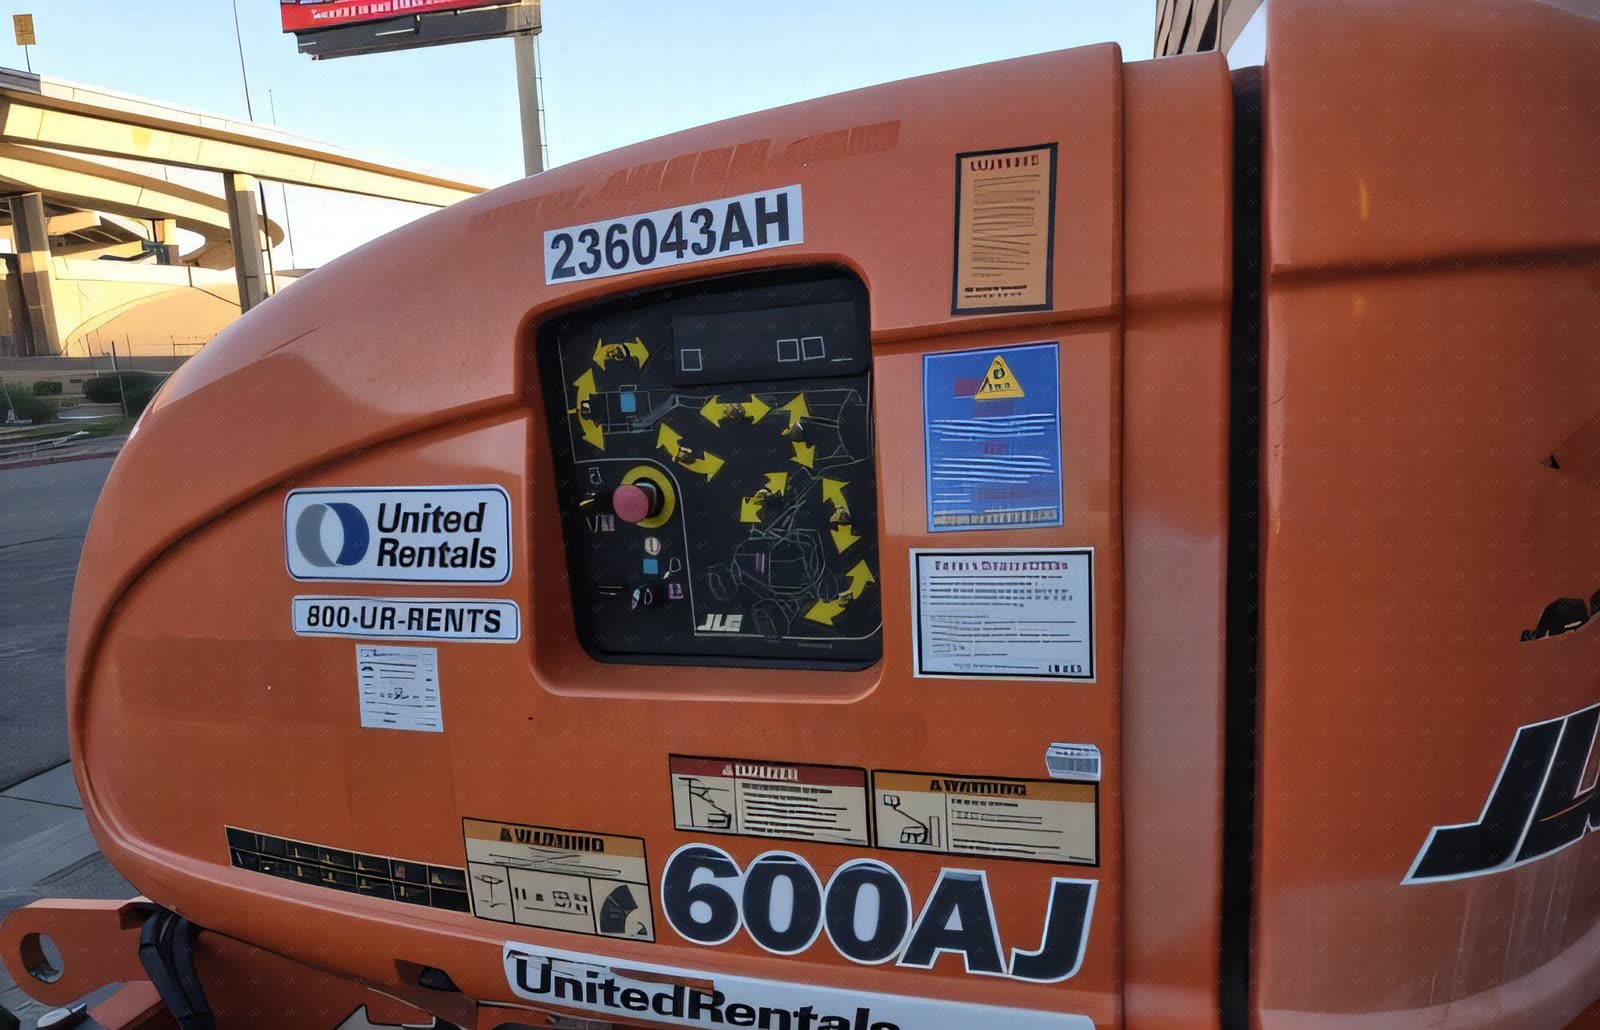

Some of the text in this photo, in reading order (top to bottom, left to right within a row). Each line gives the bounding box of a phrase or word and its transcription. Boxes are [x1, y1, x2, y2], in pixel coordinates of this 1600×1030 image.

[551, 192, 790, 280] 236043AH
[377, 538, 496, 568] Rentals
[378, 502, 487, 534] United
[1401, 703, 1600, 885] JL
[661, 844, 1098, 982] 600AJ
